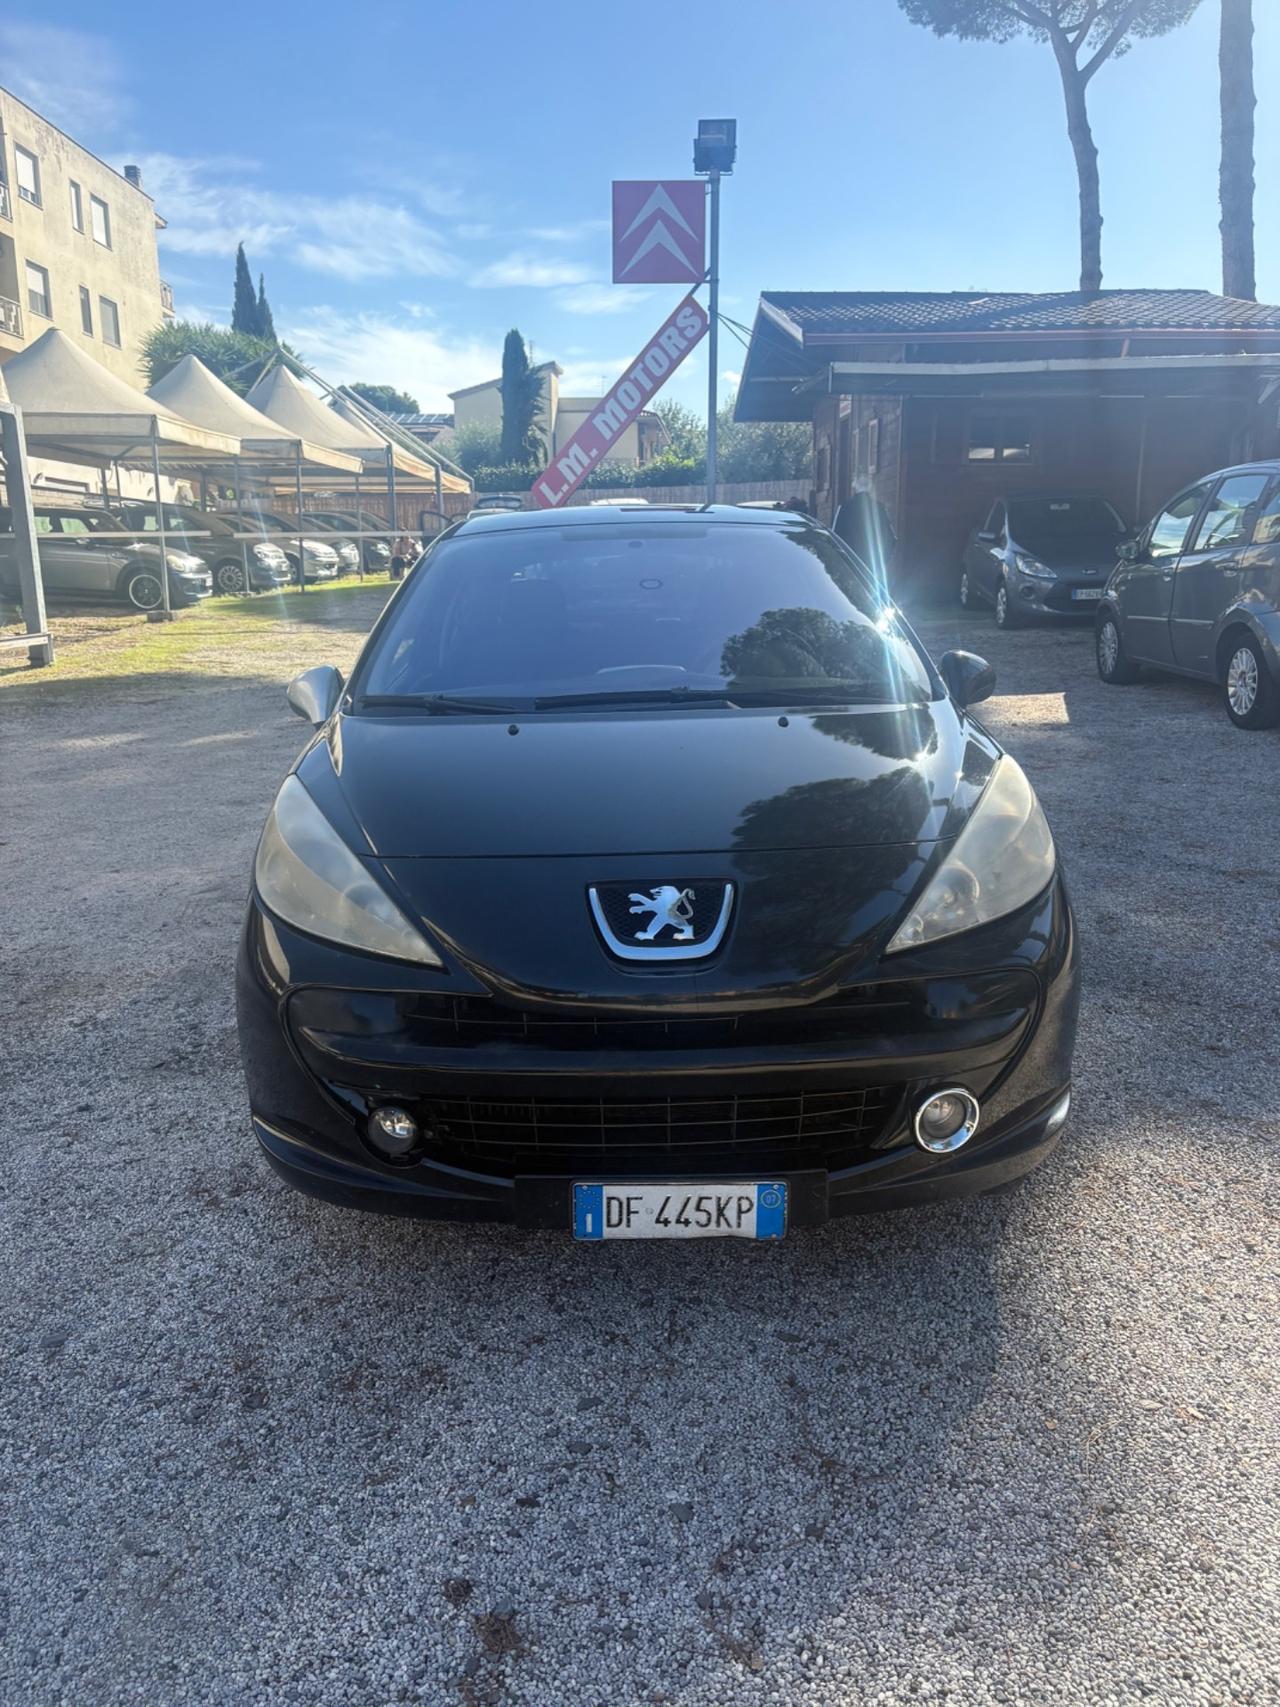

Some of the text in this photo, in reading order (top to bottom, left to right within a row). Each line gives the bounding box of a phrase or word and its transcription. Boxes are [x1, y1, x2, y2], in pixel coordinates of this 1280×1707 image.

[539, 306, 703, 505] L.M. MOTORS
[605, 1195, 755, 1229] DF 445KP
